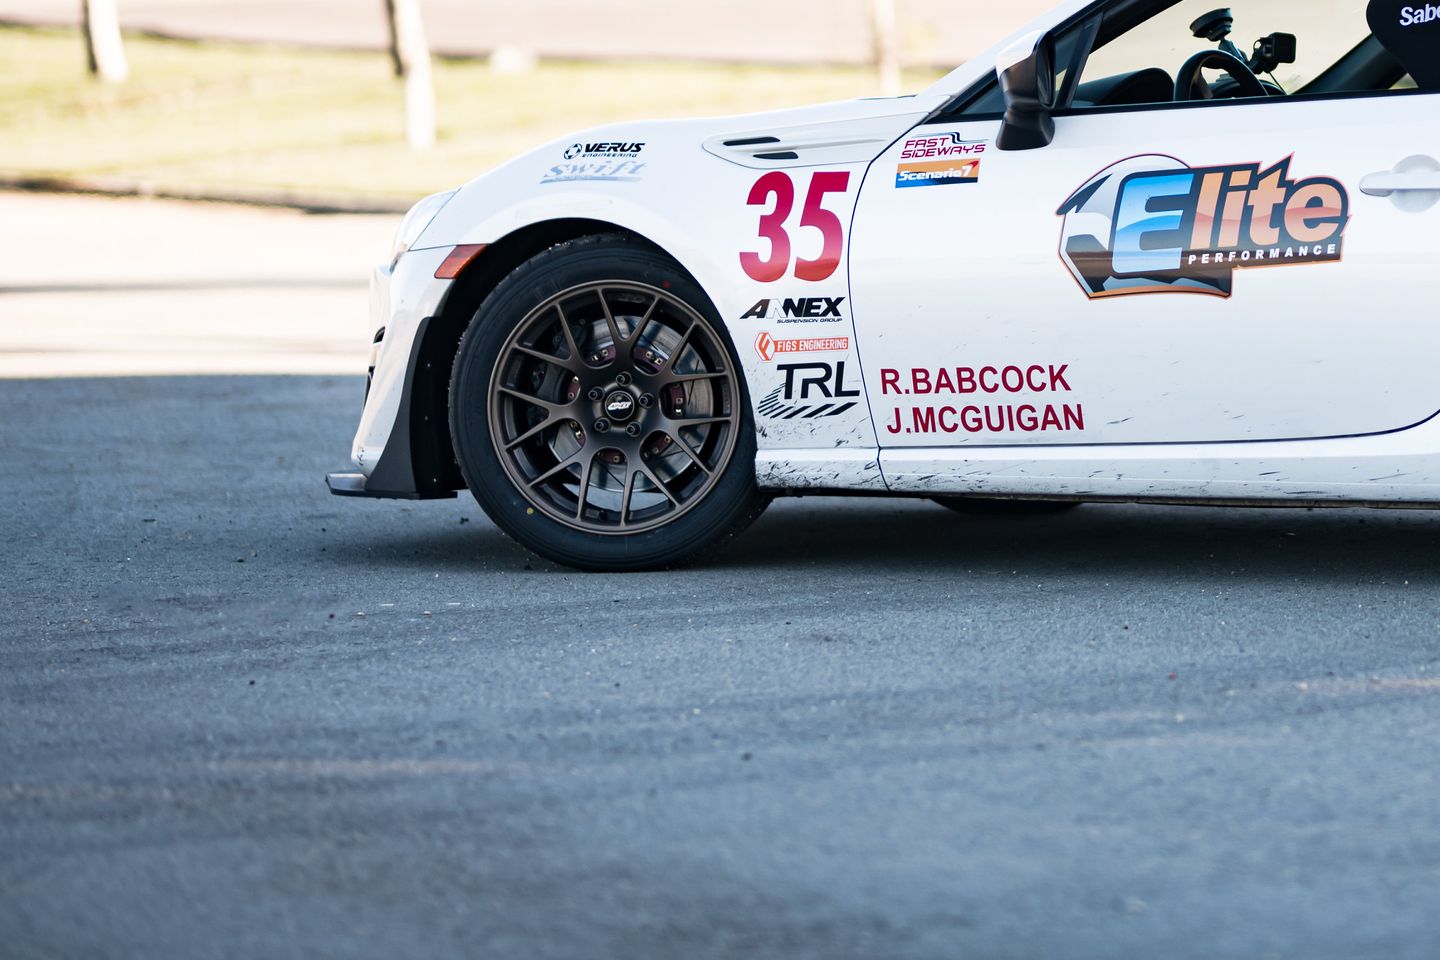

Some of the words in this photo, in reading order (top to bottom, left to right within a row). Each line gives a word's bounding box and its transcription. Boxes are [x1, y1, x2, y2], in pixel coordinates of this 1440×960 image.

[584, 142, 646, 152] VERUS
[900, 144, 986, 159] SIDEWAYS
[904, 137, 949, 149] FAST
[739, 171, 850, 282] 35
[1111, 168, 1342, 273] Elite
[1188, 244, 1336, 265] PERFORMANCE
[739, 297, 846, 319] ANNEX
[777, 341, 797, 351] FIGS
[799, 338, 848, 351] ENGINEERING
[776, 361, 860, 400] TRL
[880, 364, 1072, 395] R.BABCOCK
[886, 403, 1085, 434] J.MCGUIGAN
